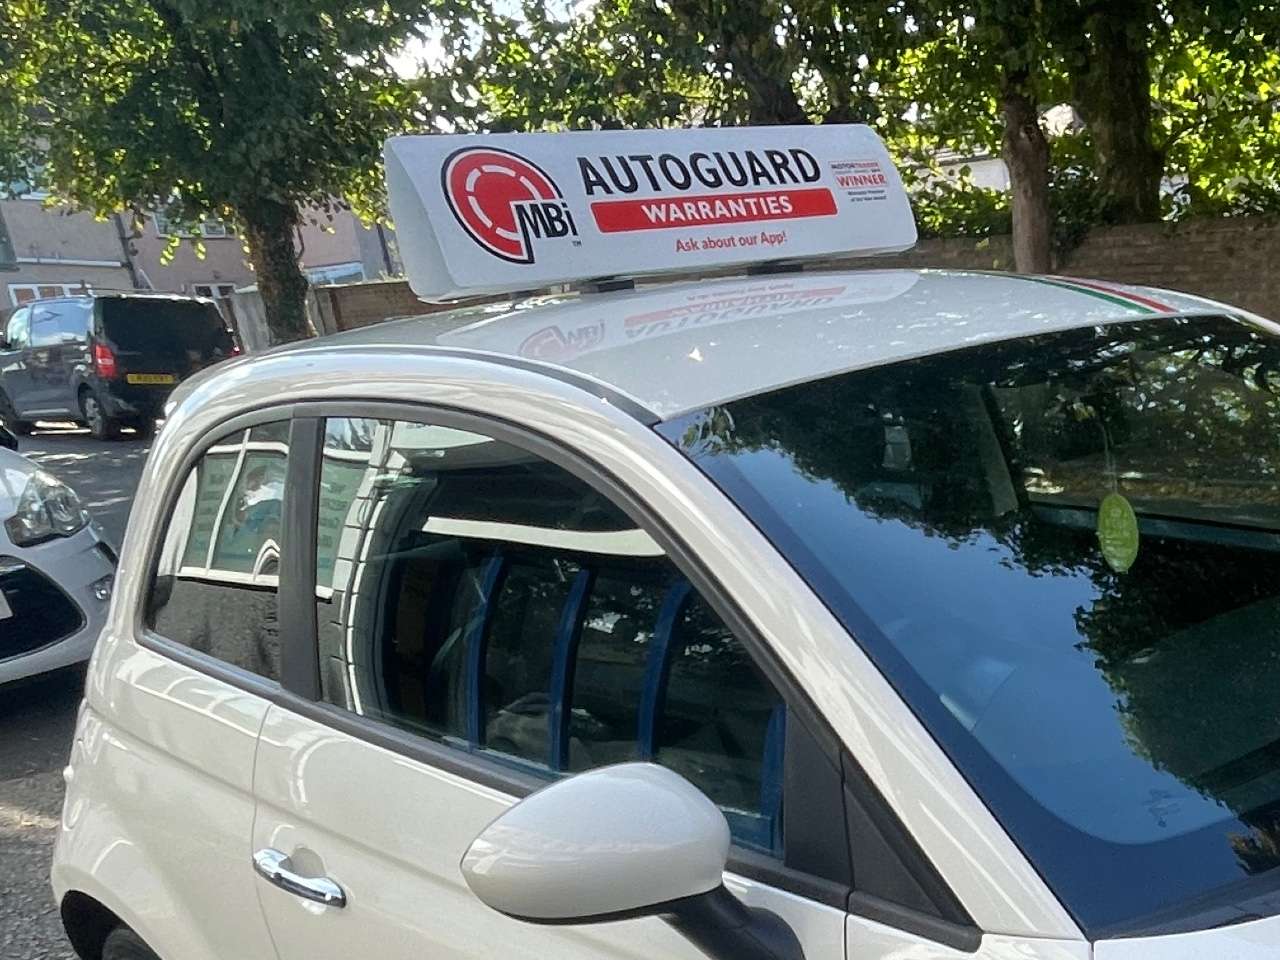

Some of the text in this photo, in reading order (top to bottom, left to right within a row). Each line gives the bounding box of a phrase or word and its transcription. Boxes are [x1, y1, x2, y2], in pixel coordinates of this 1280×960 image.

[576, 148, 821, 195] AUTOGUARD
[836, 174, 887, 187] WINNER
[513, 202, 579, 239] MBi
[641, 195, 794, 224] WARRANTIES
[676, 231, 787, 253] Ask about our App!
